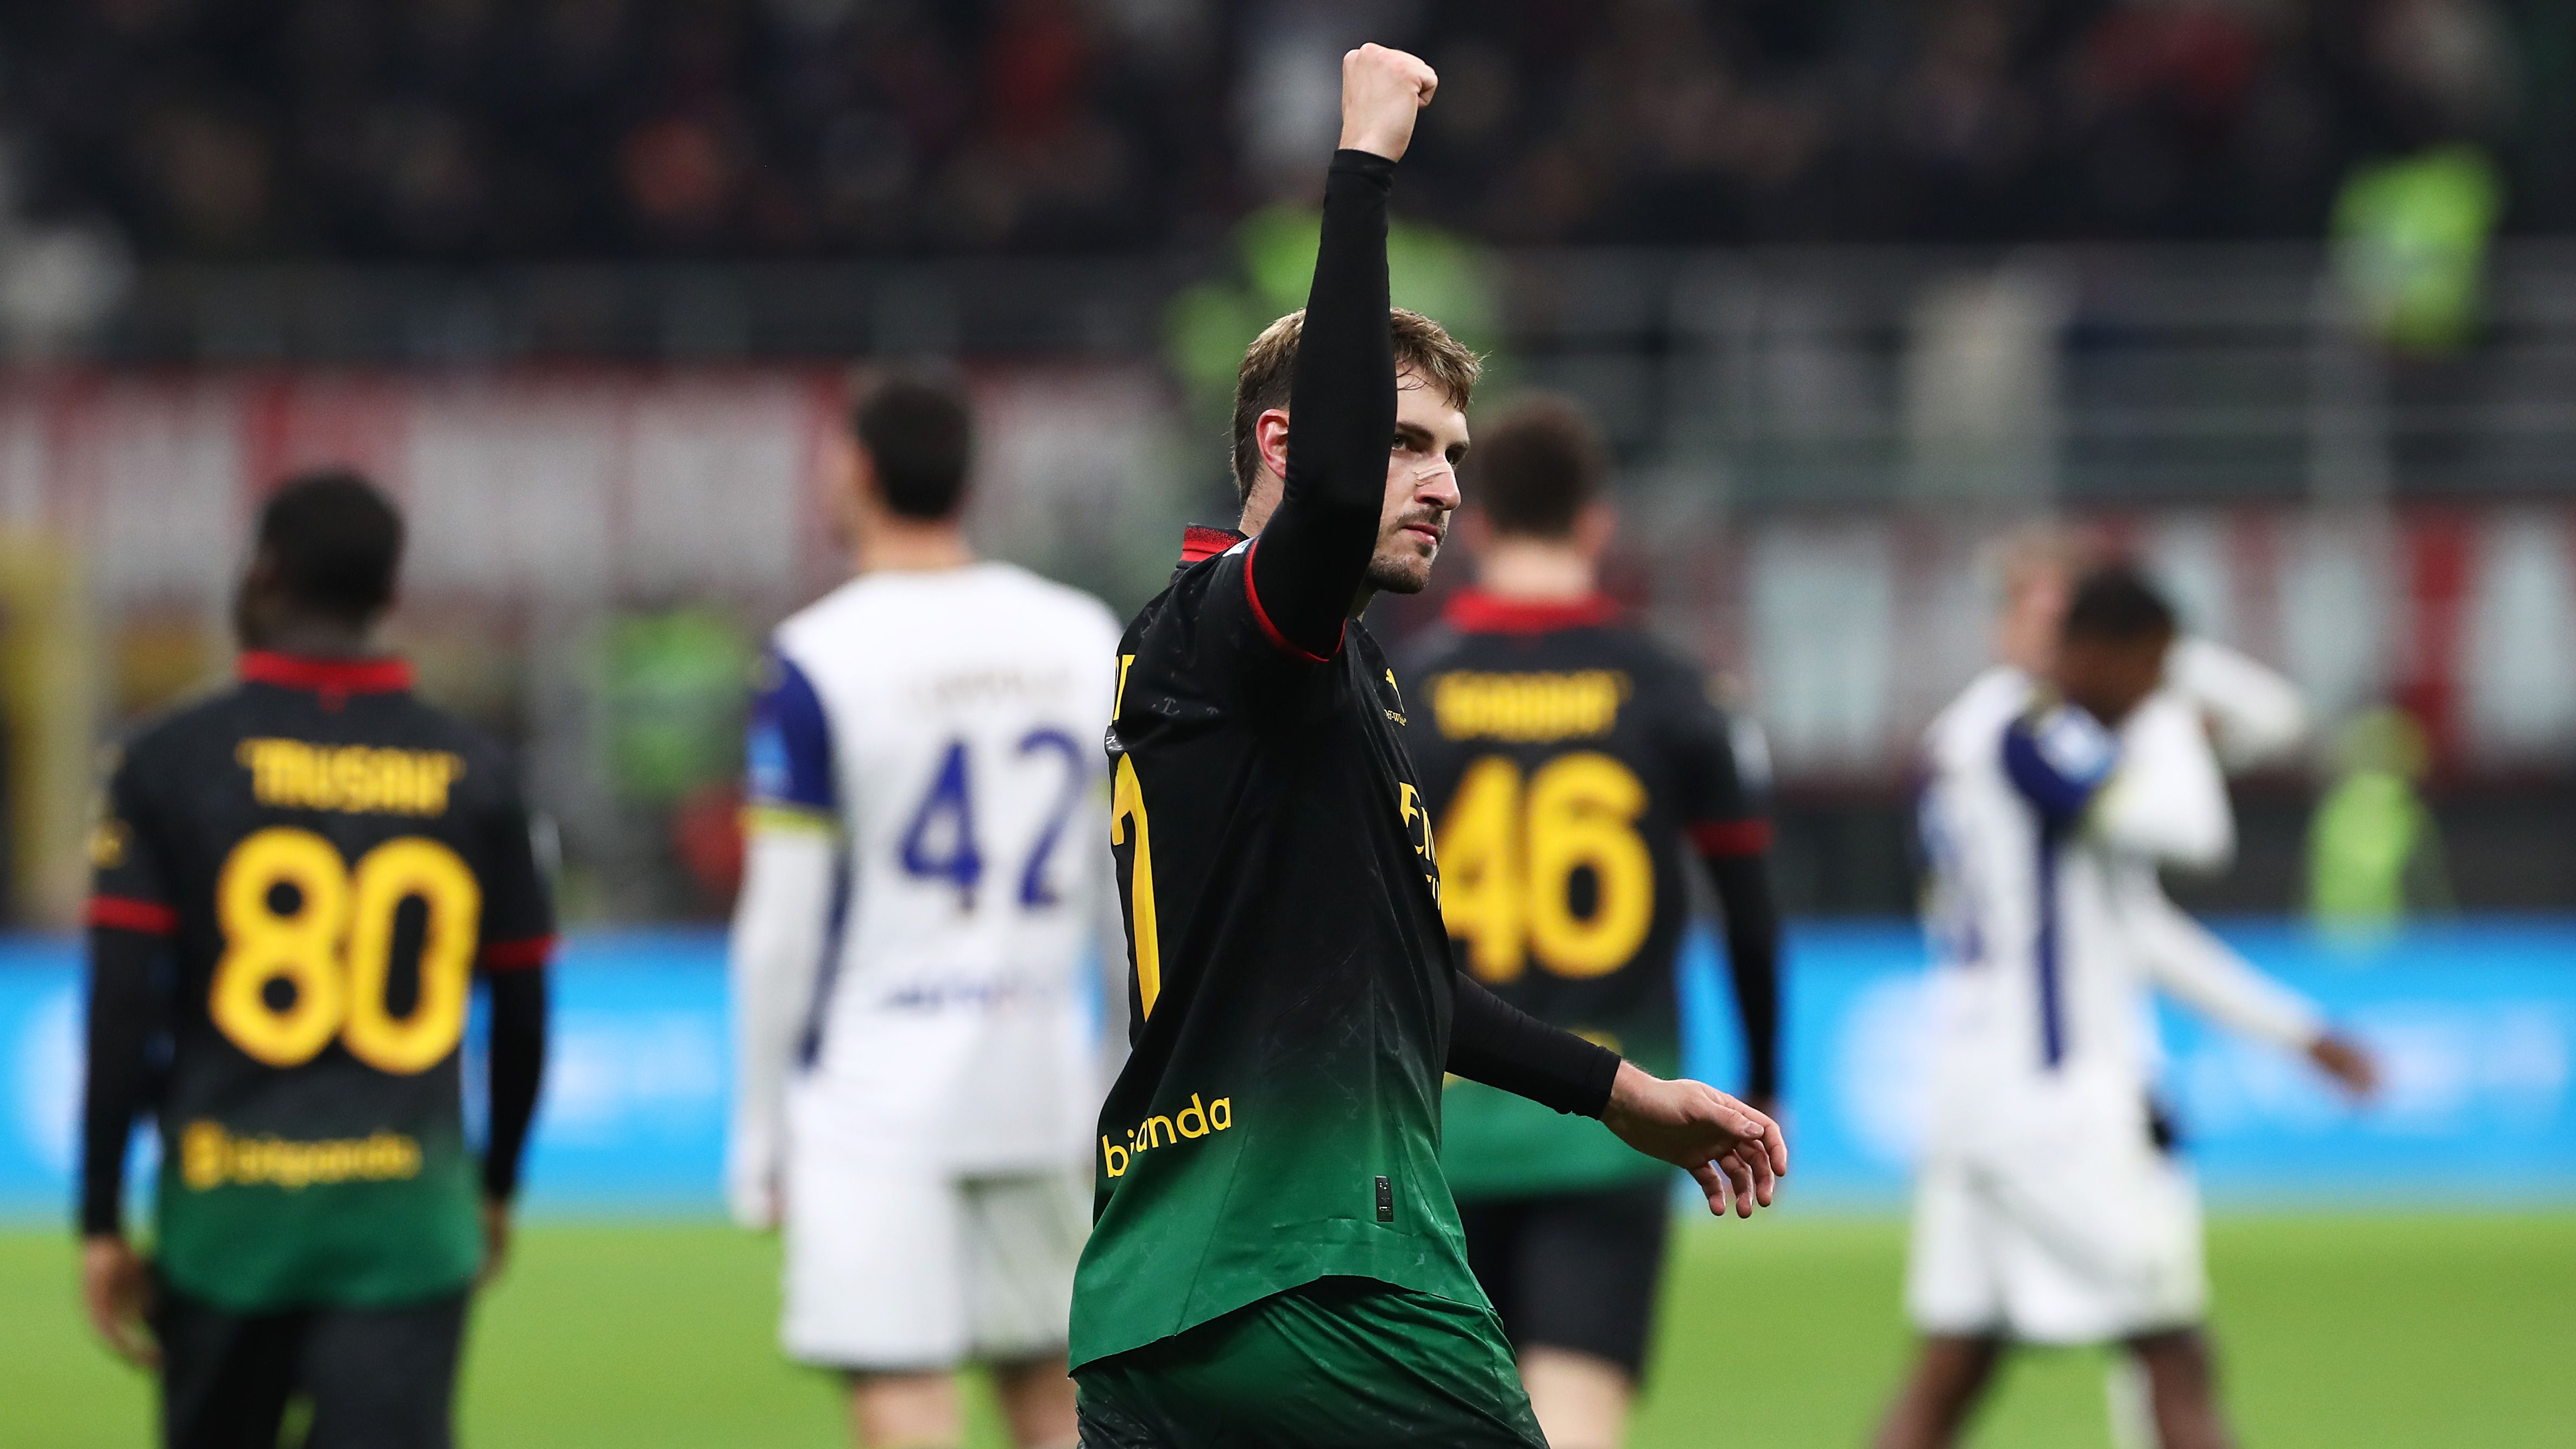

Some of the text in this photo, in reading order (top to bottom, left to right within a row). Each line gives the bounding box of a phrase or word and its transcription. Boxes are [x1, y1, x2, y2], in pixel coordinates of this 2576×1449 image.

[899, 725, 1088, 915] 42
[1436, 752, 1653, 980] 46
[211, 828, 480, 1074] 80
